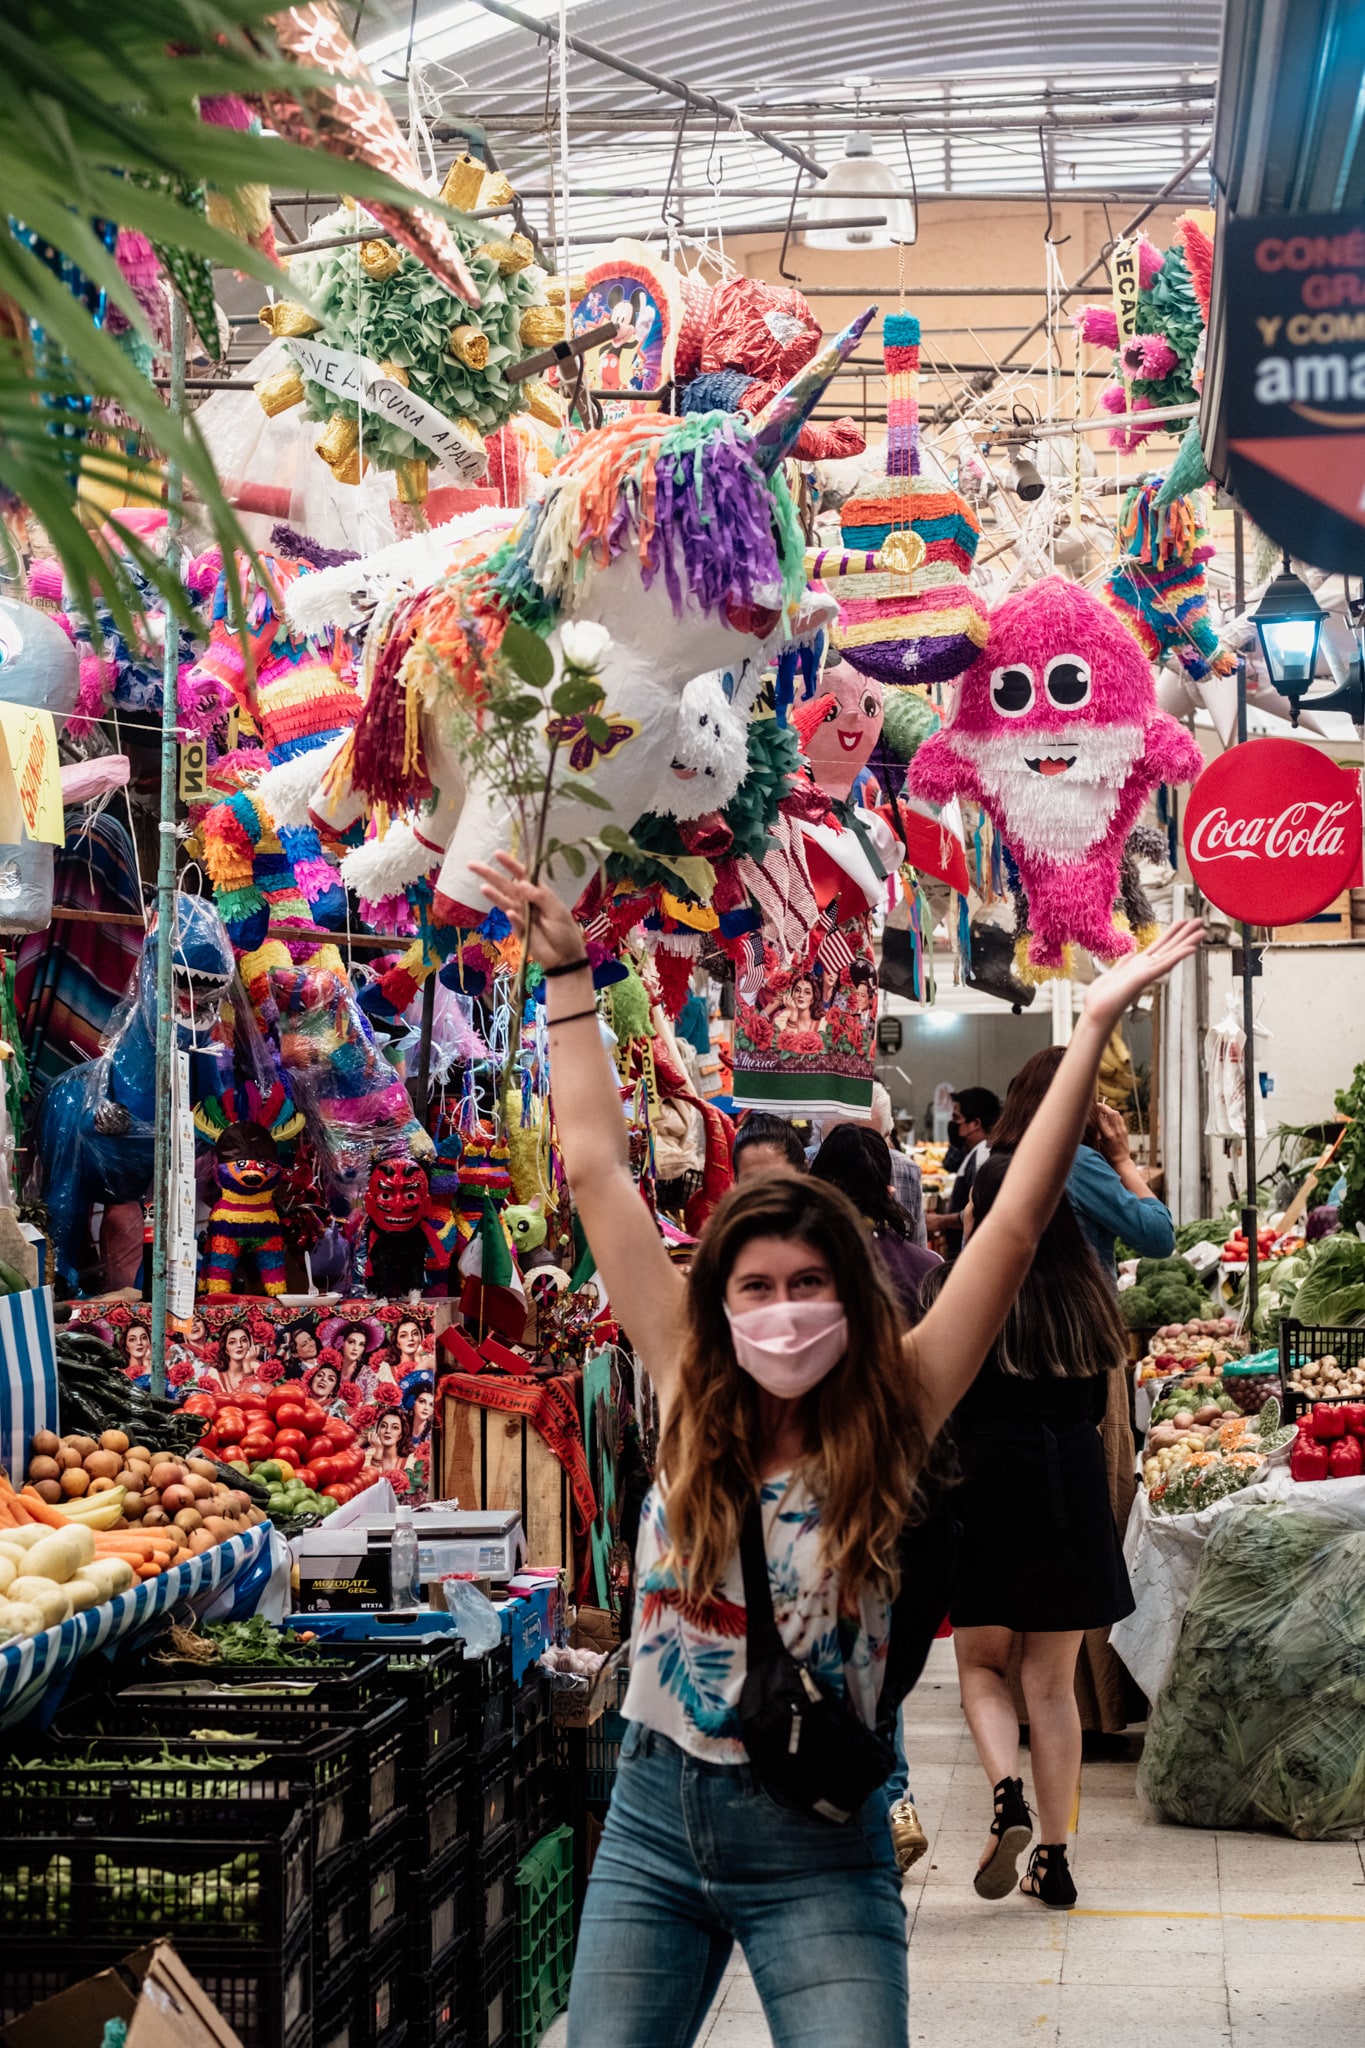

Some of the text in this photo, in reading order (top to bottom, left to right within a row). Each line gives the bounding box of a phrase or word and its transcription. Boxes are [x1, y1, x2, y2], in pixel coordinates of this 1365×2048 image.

[1116, 246, 1136, 335] ECAU
[1256, 316, 1283, 346] Y
[1190, 800, 1355, 863] Coca-Cola
[312, 1579, 369, 1590] MOTOBATT
